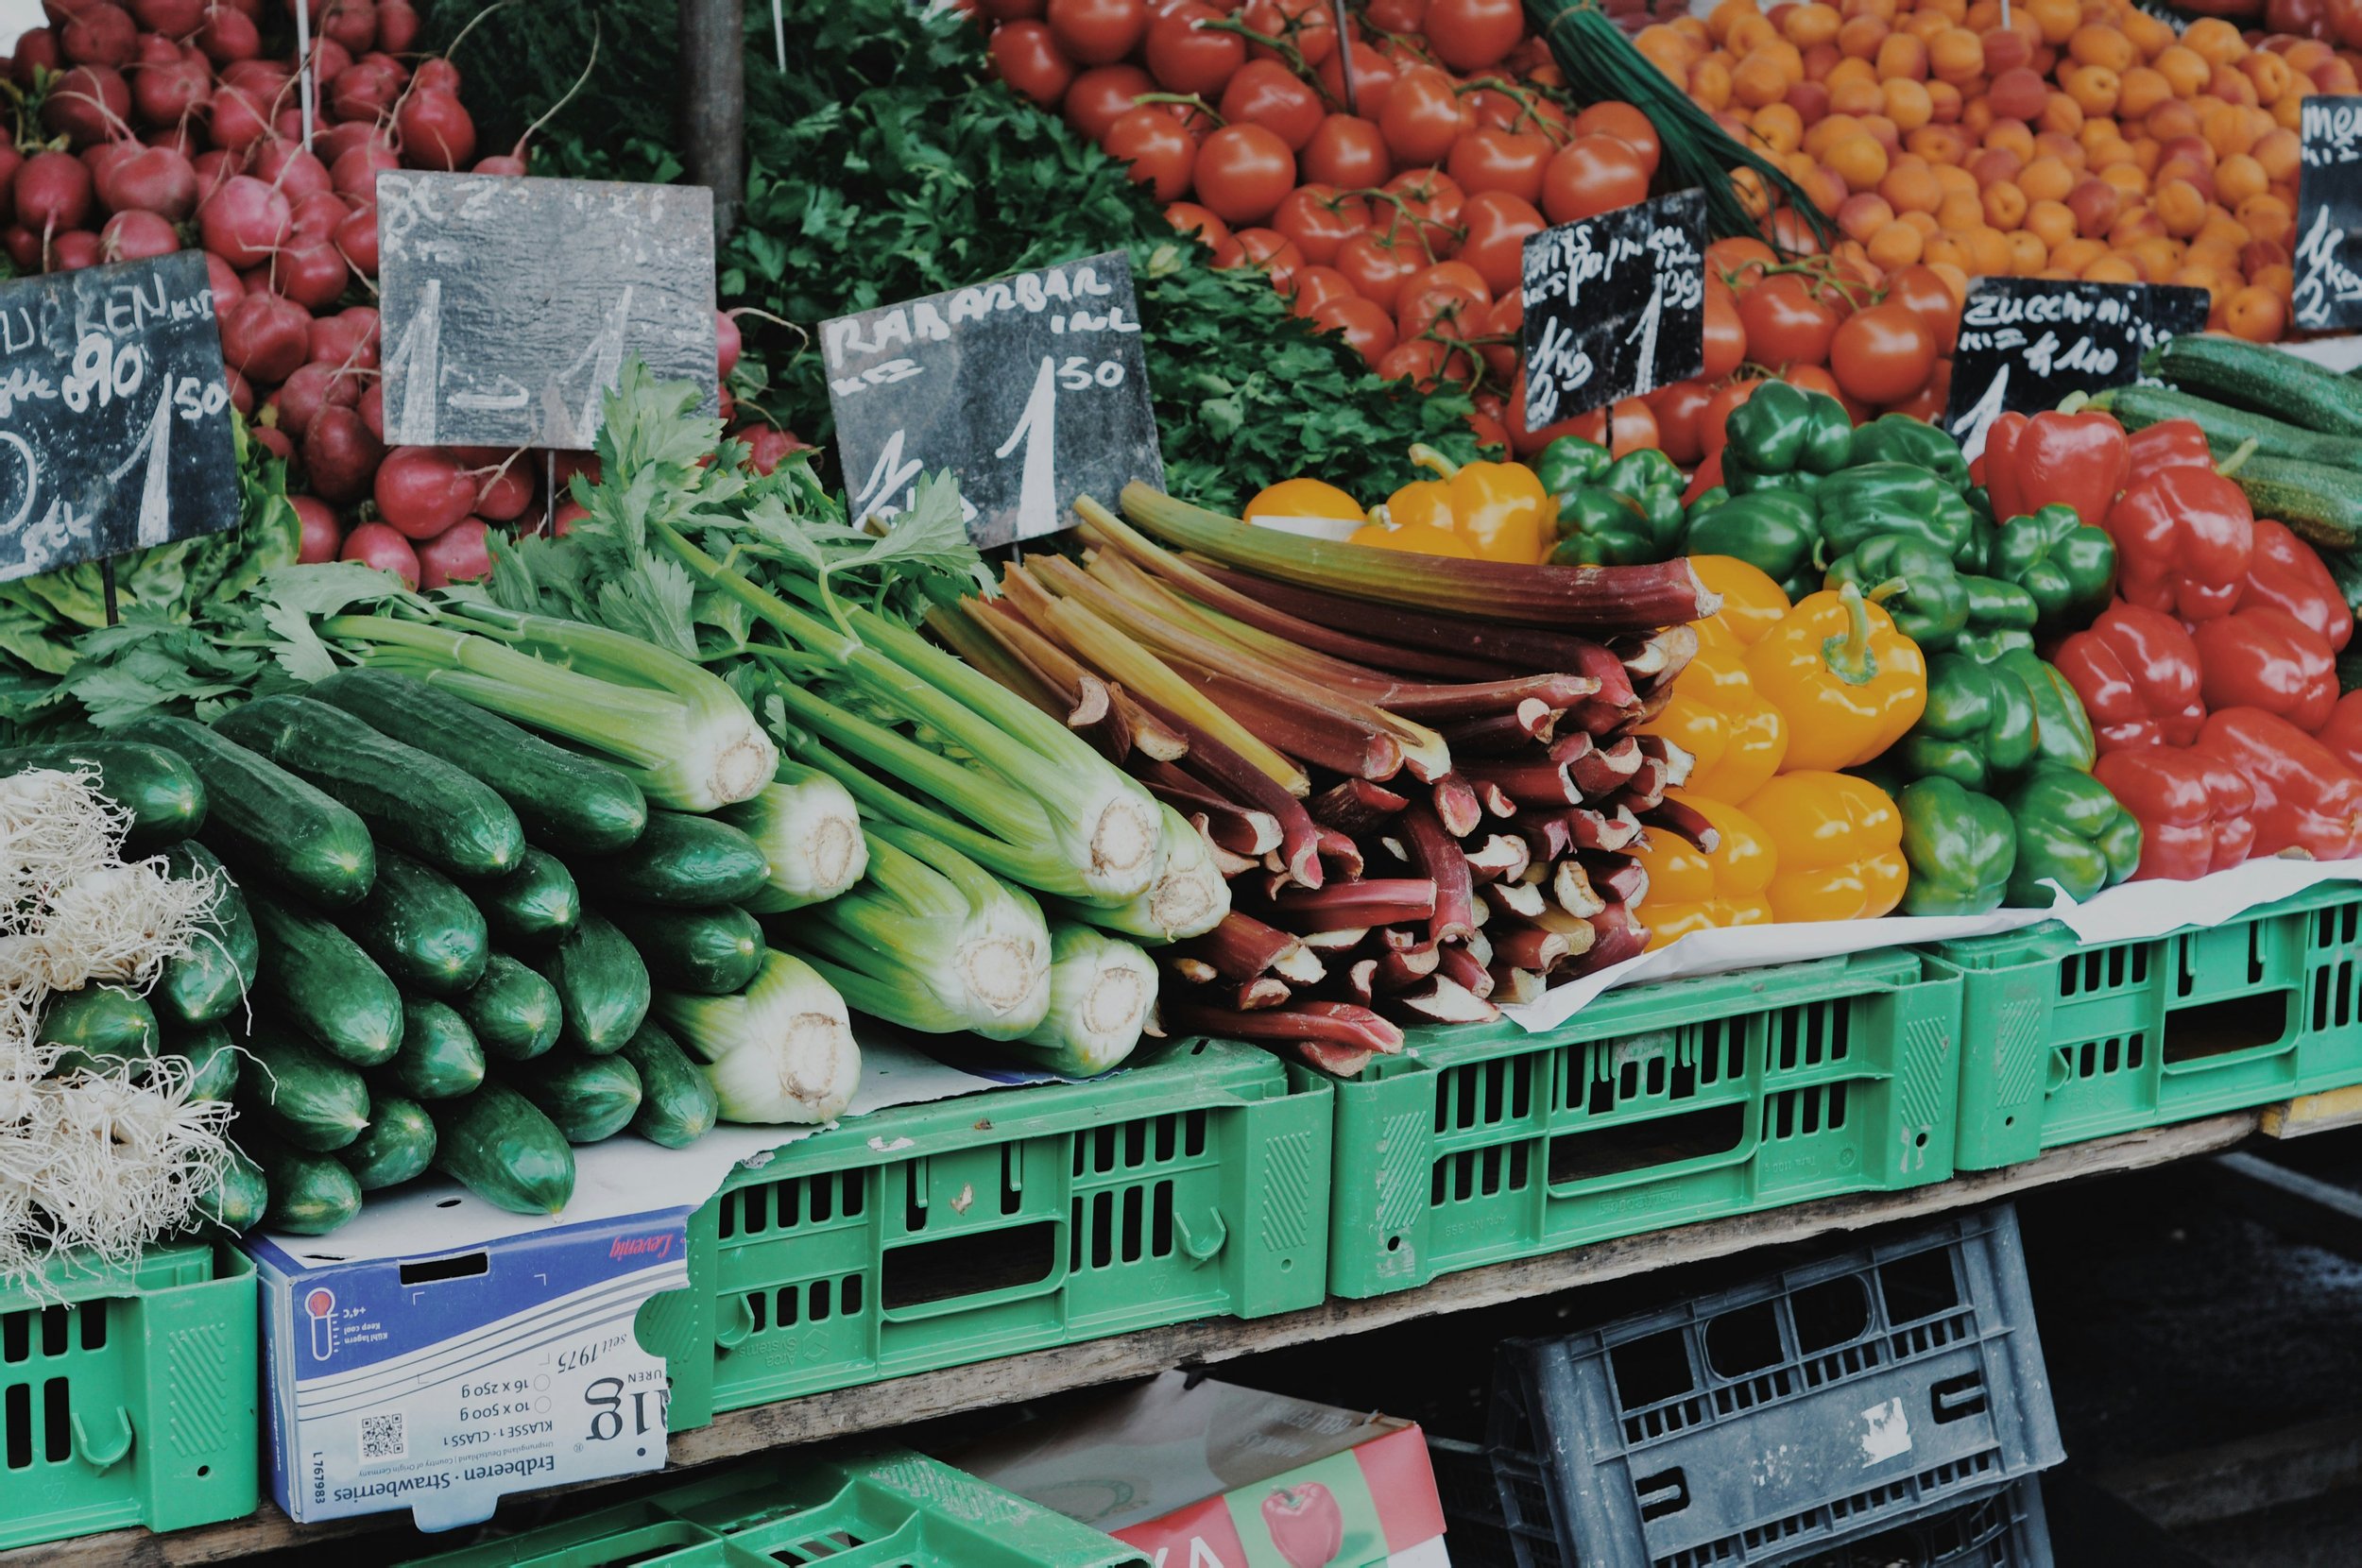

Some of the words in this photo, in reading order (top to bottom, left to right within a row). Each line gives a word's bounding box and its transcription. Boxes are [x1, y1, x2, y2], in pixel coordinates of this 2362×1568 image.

[1056, 356, 1125, 390] 50
[343, 1325, 360, 1336] cool
[361, 1322, 381, 1331] Keep
[603, 1334, 627, 1354] seit
[557, 1343, 598, 1373] 1975
[461, 1384, 471, 1398] g
[474, 1382, 498, 1396] 250
[514, 1379, 529, 1393] 16
[460, 1407, 469, 1422] g
[472, 1403, 499, 1420] 500
[515, 1402, 530, 1413] 10
[507, 1420, 553, 1438] KLASSE
[452, 1430, 490, 1447] CLASS
[425, 1457, 454, 1467] Country
[458, 1449, 502, 1463] Deutschland
[359, 1468, 391, 1477] Germany
[464, 1456, 555, 1481] Erdbeeren
[314, 1460, 326, 1505] 767983
[334, 1473, 451, 1503] Strawberries
